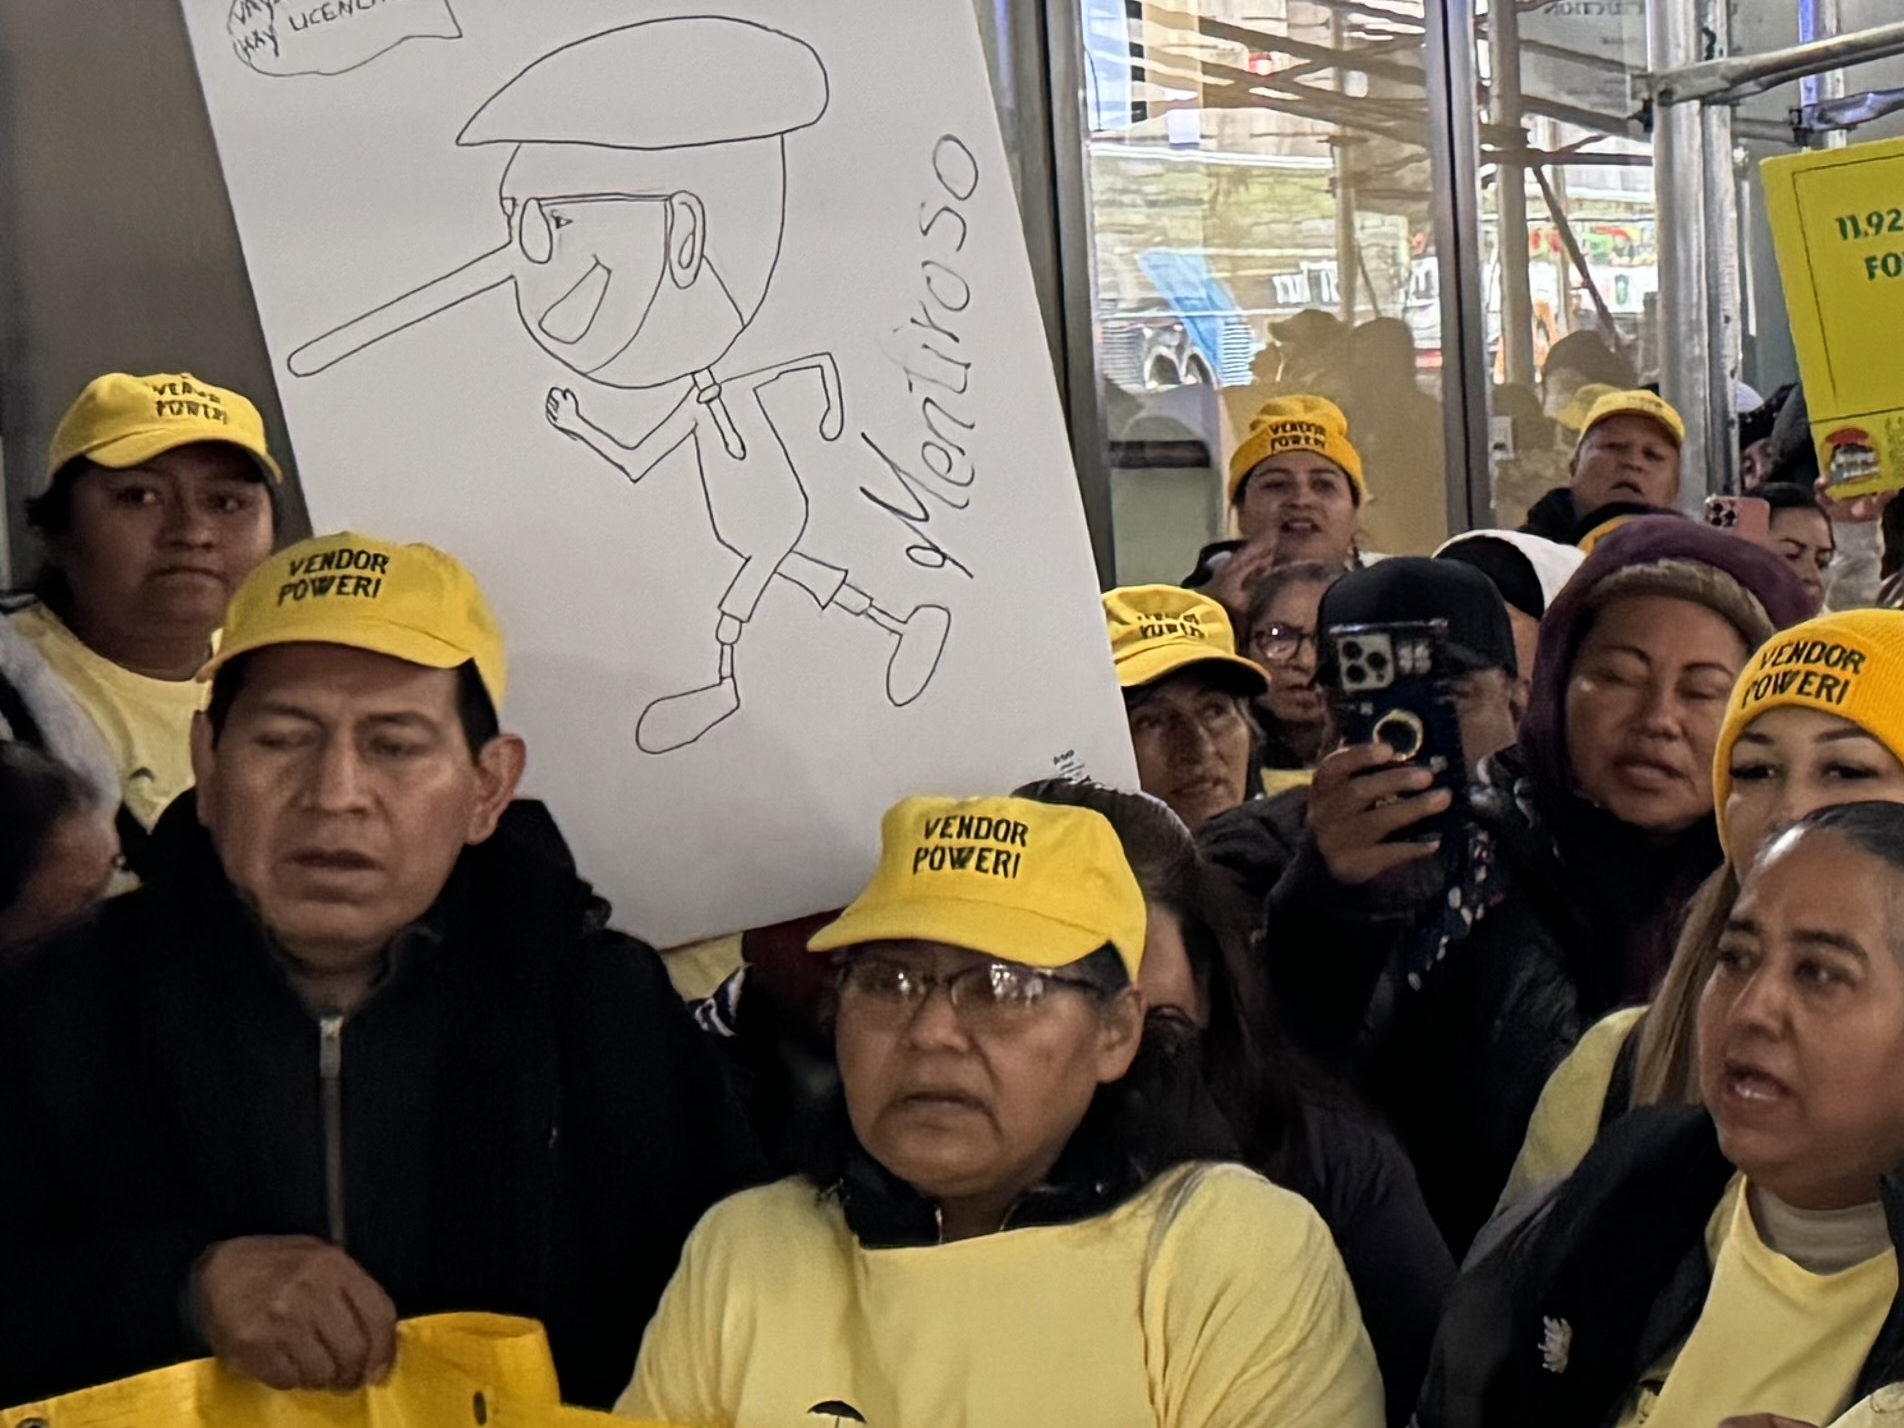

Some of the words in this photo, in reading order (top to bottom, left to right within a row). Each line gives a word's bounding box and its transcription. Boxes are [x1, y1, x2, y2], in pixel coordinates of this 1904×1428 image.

[290, 548, 390, 576] VENDOR
[1759, 639, 1867, 675] VENDOR
[924, 814, 1029, 848] VENDOR
